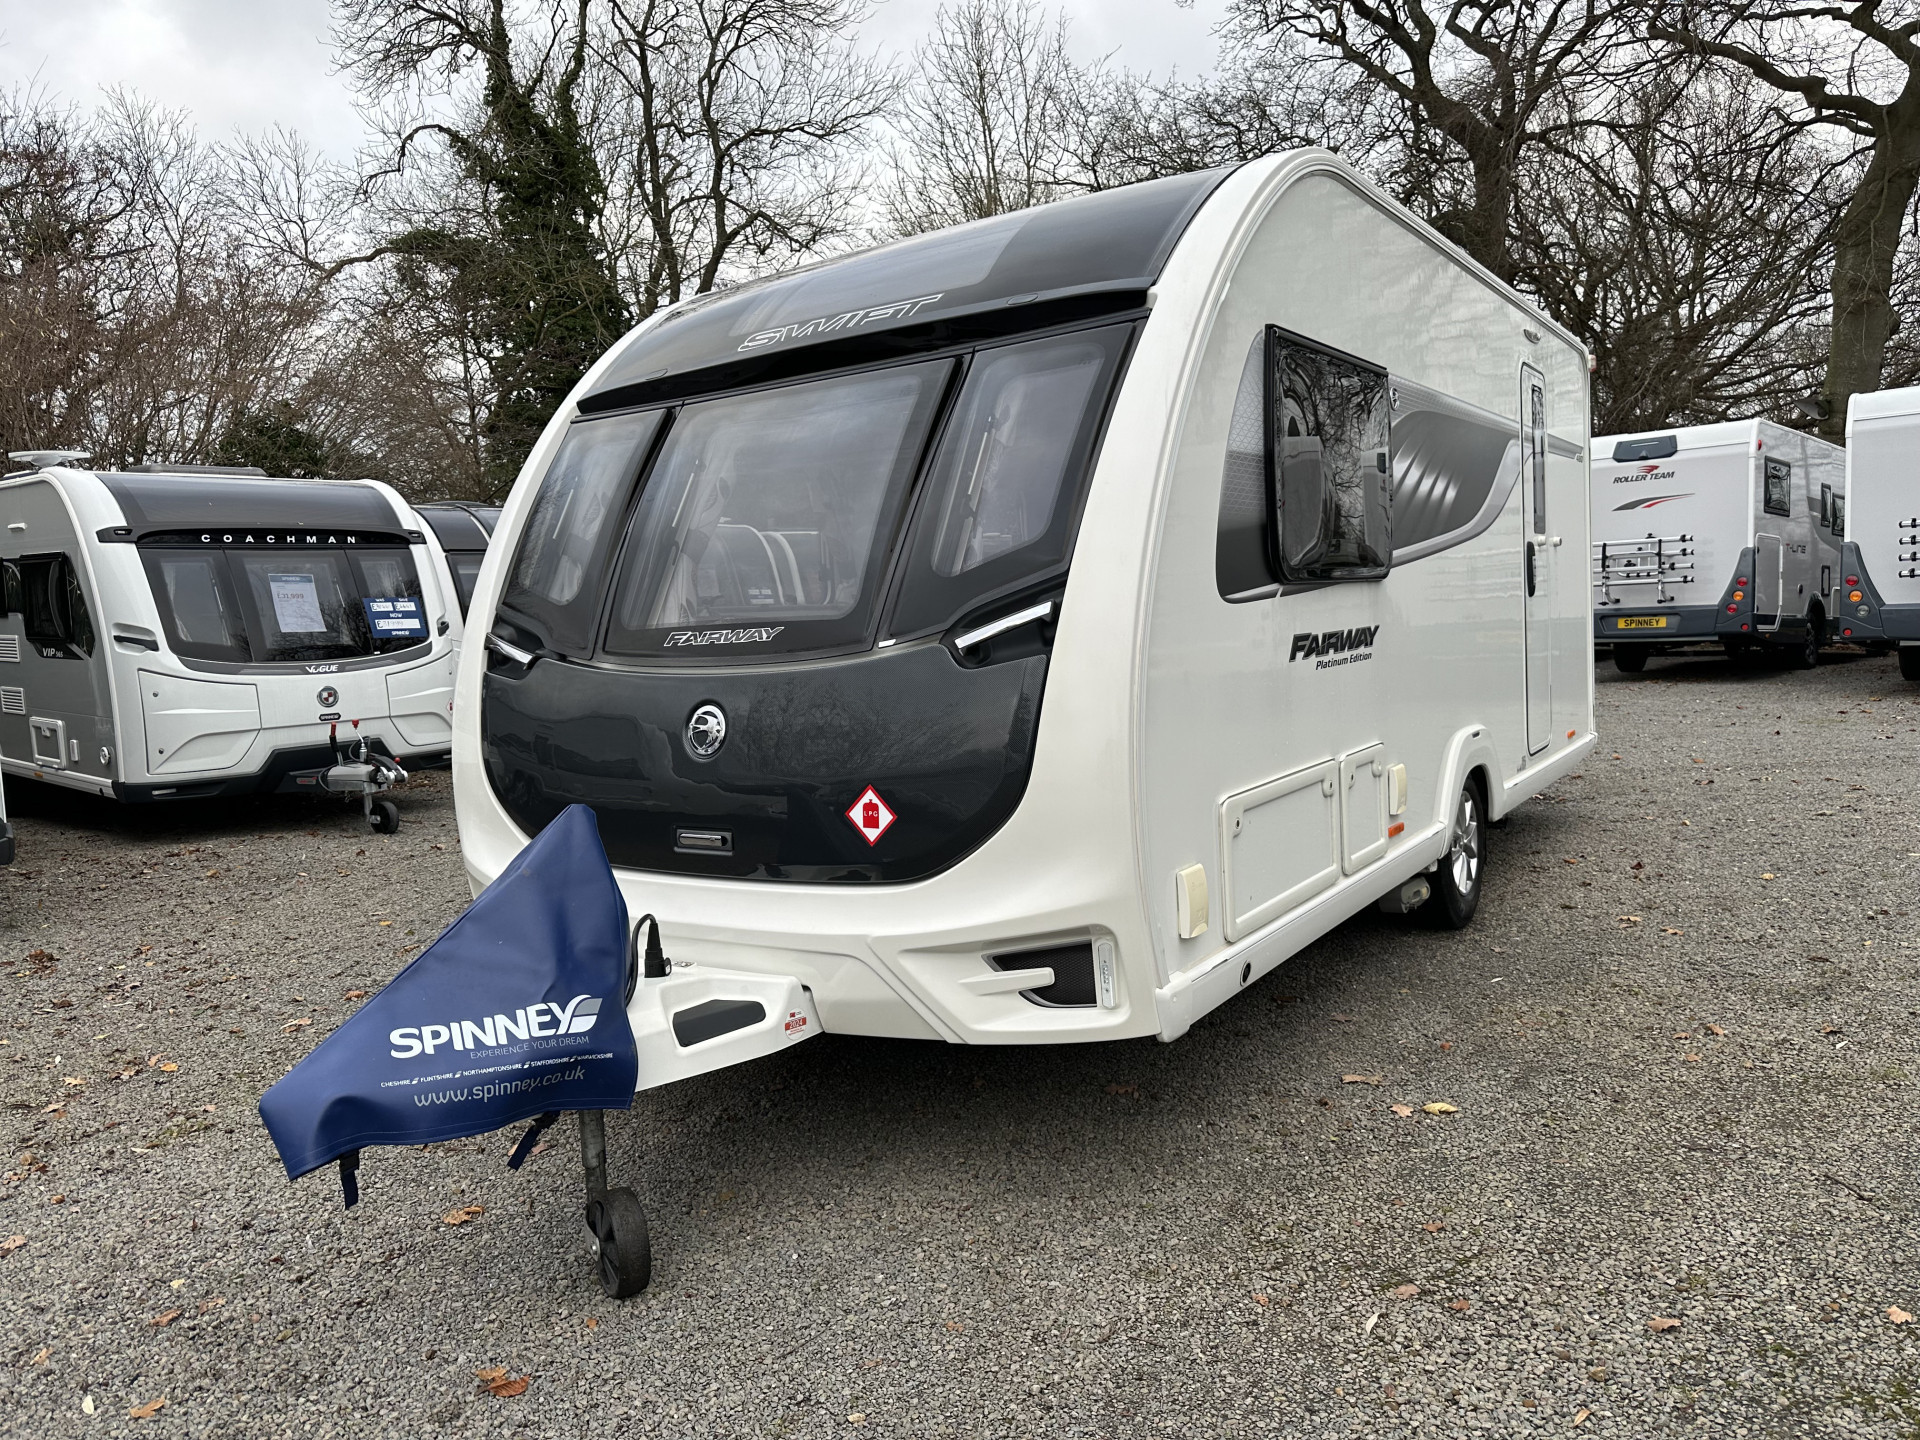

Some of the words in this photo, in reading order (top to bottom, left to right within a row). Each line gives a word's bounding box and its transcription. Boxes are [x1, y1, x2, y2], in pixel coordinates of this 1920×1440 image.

[738, 293, 945, 352] SWIFT
[1613, 474, 1648, 484] ROLLER
[1649, 471, 1675, 480] TEAM
[201, 534, 356, 544] COACHMAN
[1624, 618, 1660, 627] SPINNEY
[664, 626, 785, 646] FAIRWAY
[1289, 624, 1380, 663] FAIRWAY
[42, 647, 56, 657] VIP
[1315, 657, 1348, 670] Platinum
[1349, 653, 1372, 663] Edition
[389, 994, 592, 1059] SPINNEY
[470, 1043, 530, 1060] EXPERIENCE
[531, 1040, 557, 1049] YOUR
[559, 1036, 590, 1047] DREAM
[380, 1079, 411, 1088] CHESHIRE
[420, 1073, 454, 1083] FLINTSHIRE
[462, 1064, 522, 1076] NORTHAMPTONSHIRE
[530, 1056, 570, 1068] STAFFORDSHIRE
[413, 1065, 586, 1107] www.spinney.co.uk
